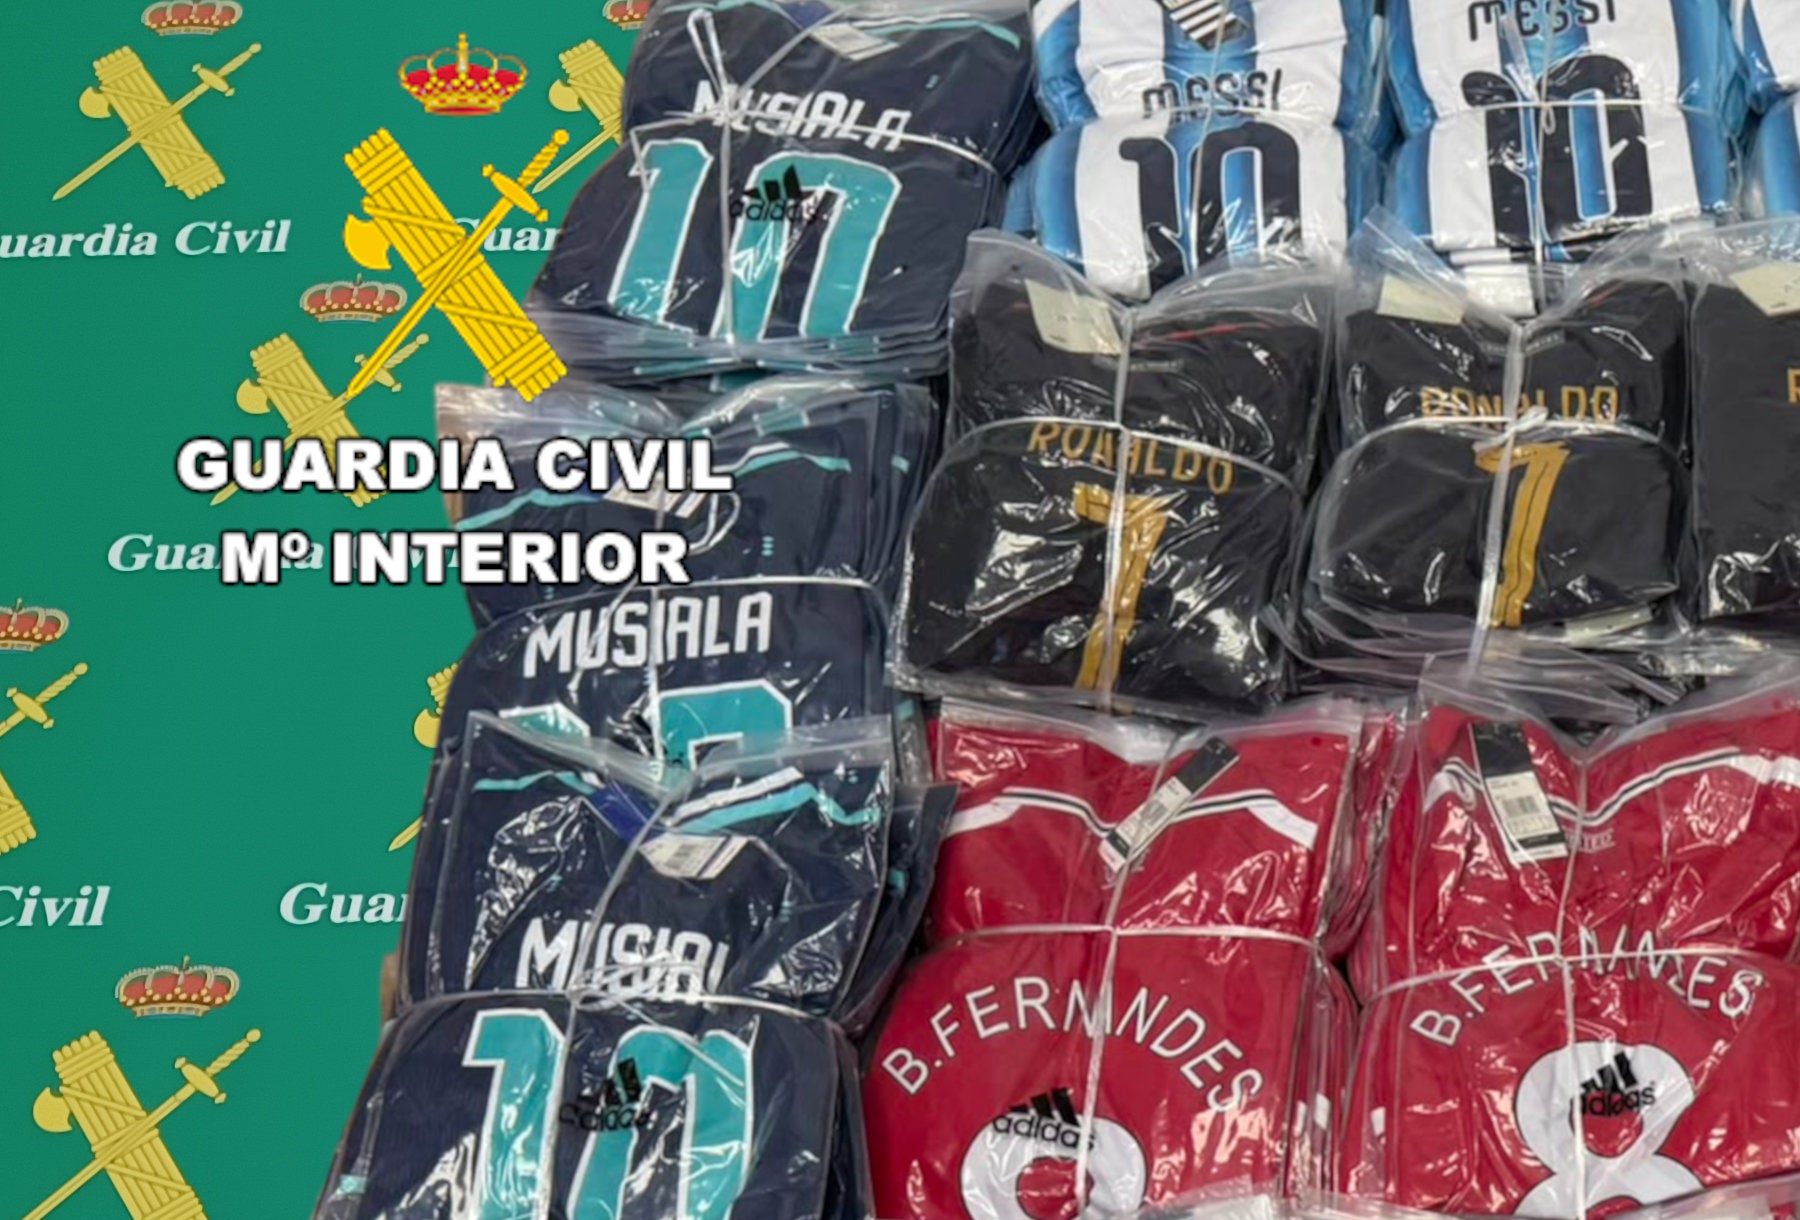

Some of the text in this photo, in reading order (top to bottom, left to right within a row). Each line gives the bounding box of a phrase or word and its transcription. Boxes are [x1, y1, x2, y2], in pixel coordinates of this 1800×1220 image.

[1141, 67, 1283, 123] MESSI
[0, 219, 291, 259] uardia Civil
[606, 138, 903, 341] 10
[1117, 119, 1301, 300] 10
[524, 592, 773, 680] MUSIALA
[992, 1112, 1097, 1154] adidas
